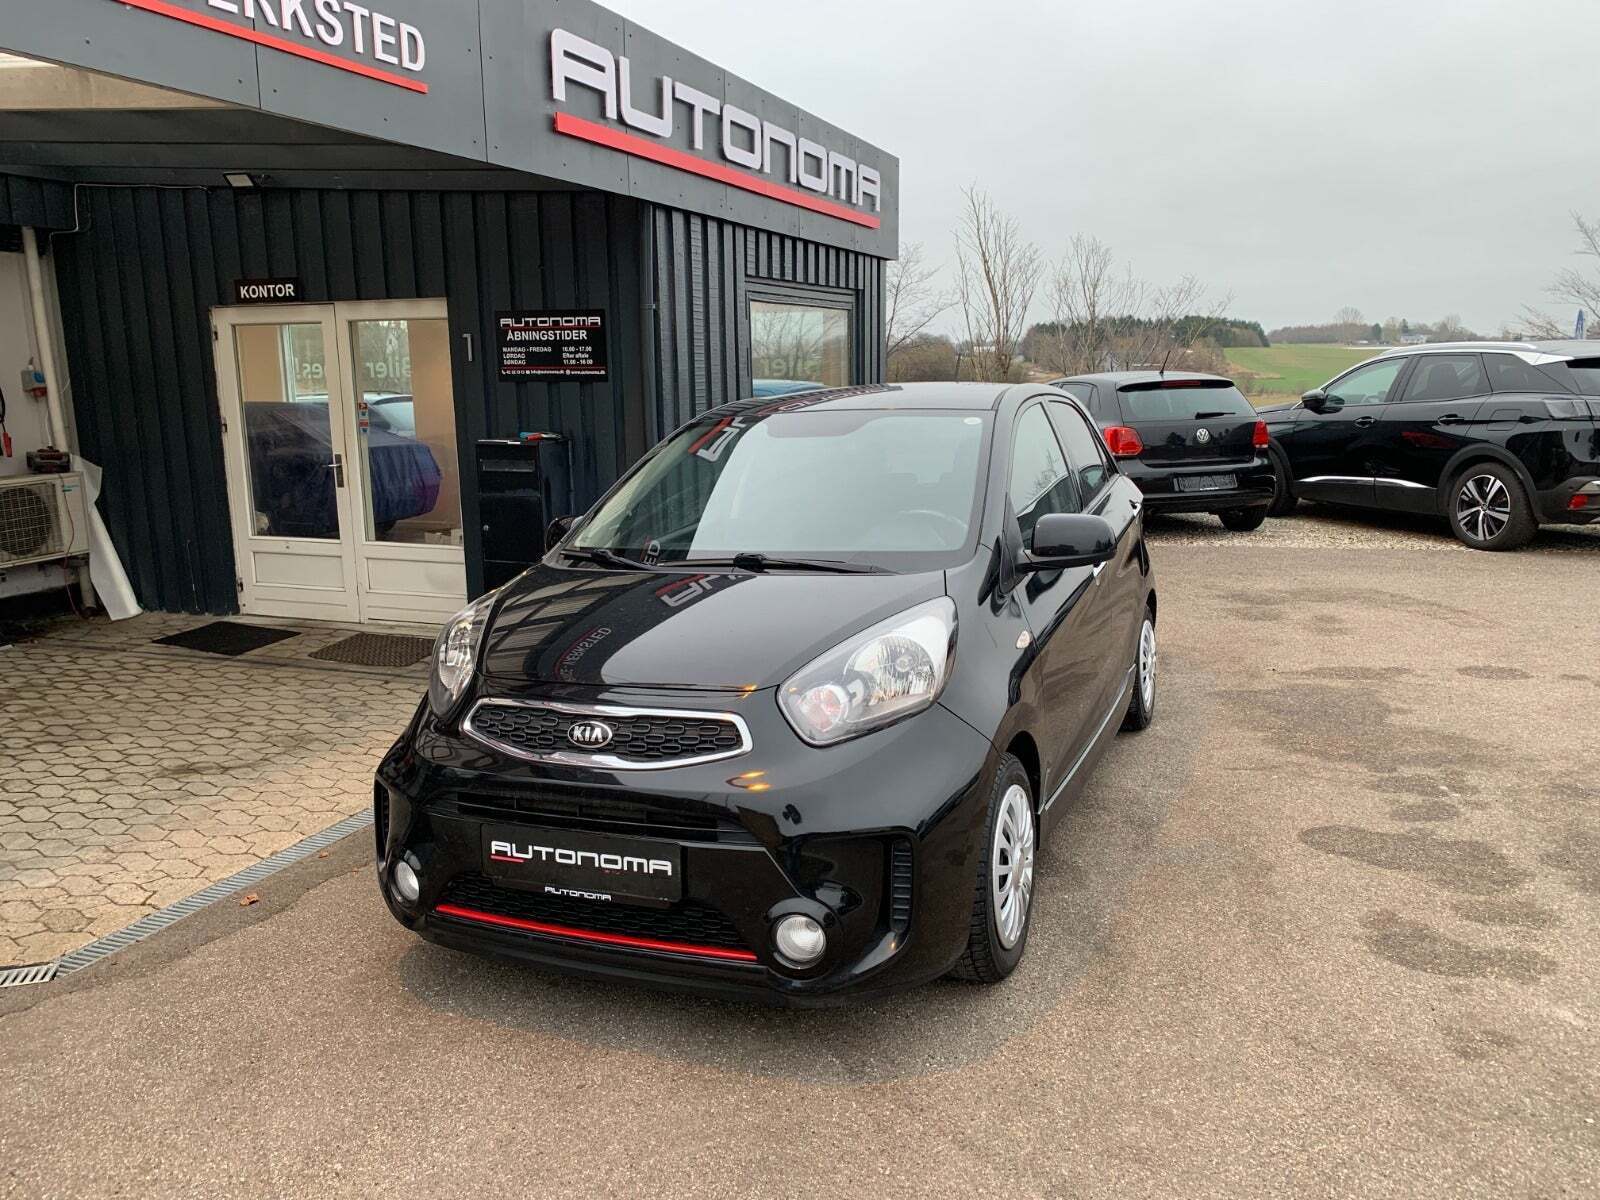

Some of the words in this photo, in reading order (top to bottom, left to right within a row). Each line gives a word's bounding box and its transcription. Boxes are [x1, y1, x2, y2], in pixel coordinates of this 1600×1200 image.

[208, 0, 425, 72] KSTED
[551, 28, 881, 212] AUTONOMA
[240, 283, 295, 299] KONTOR
[500, 316, 601, 328] AUTONOMA
[506, 330, 588, 341] ÅBNINGSTIDER
[573, 726, 603, 743] KIA
[491, 840, 673, 876] AUTONOMA
[544, 885, 612, 901] AUTONOMA
